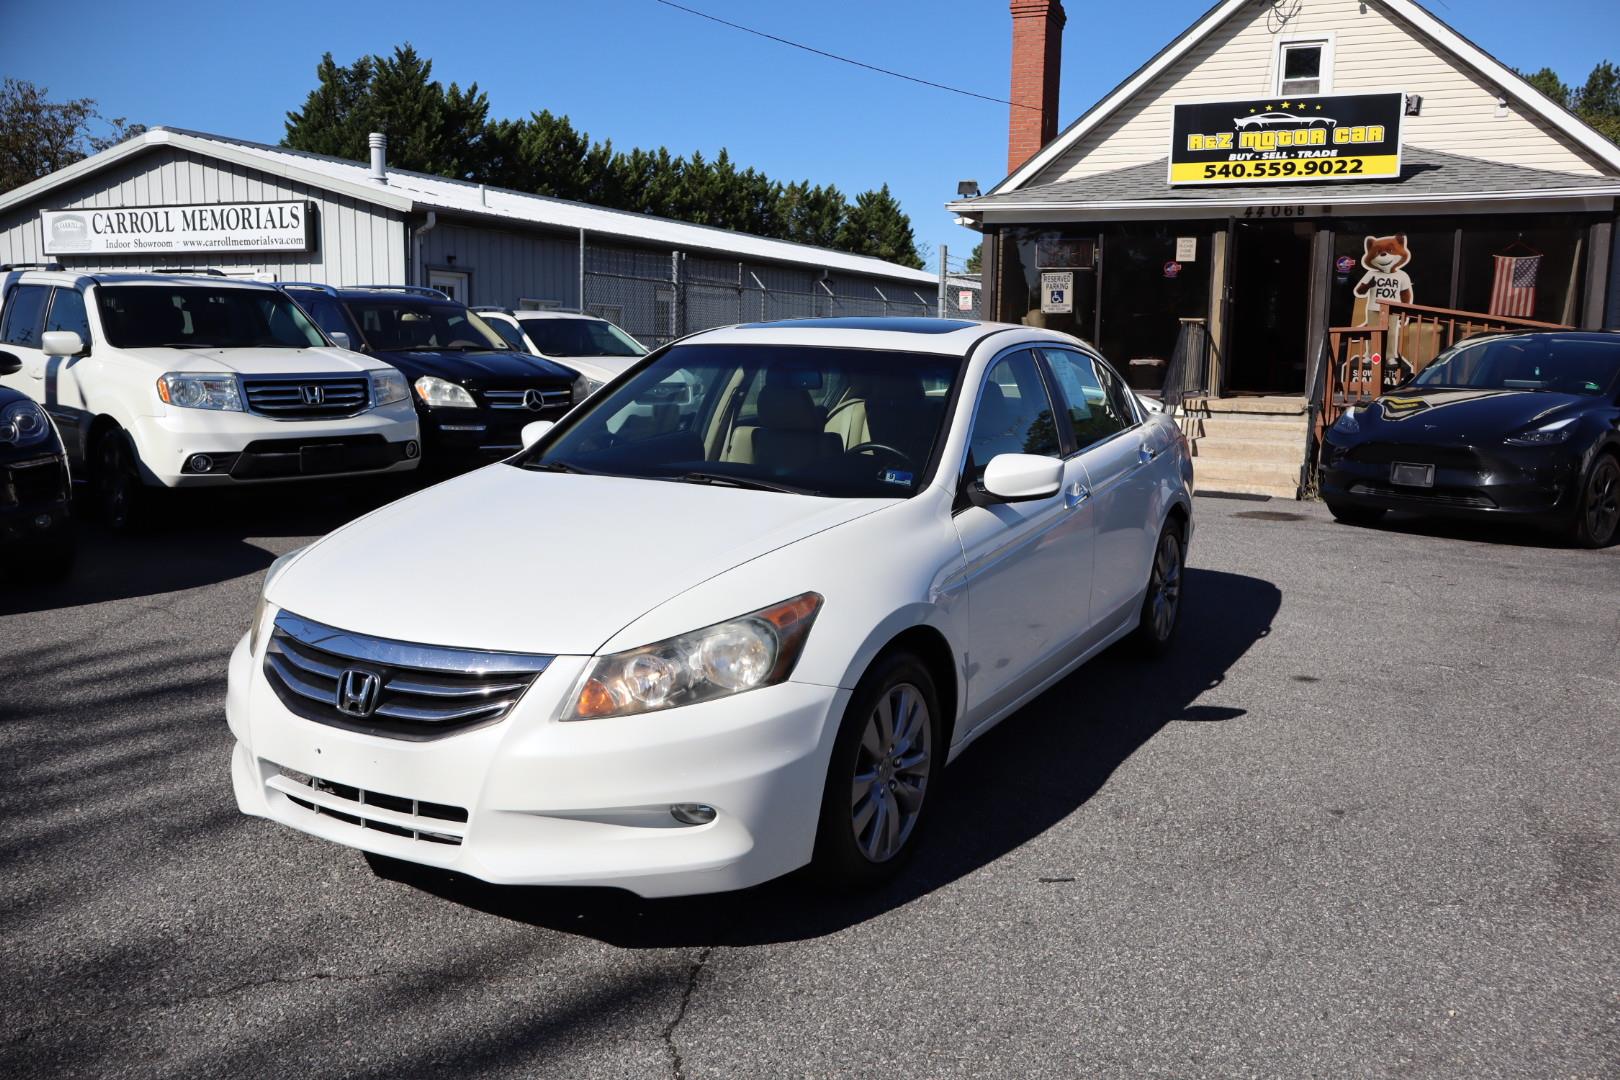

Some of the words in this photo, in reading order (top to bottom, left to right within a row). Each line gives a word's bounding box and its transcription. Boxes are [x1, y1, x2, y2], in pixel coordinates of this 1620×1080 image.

[1228, 152, 1254, 161] BUY
[1261, 151, 1289, 160] SELL
[1297, 149, 1339, 159] TRADE
[1203, 158, 1363, 179] 540.559.9022
[92, 211, 175, 235] CARROLL
[181, 205, 300, 232] MEMORIALS
[105, 238, 131, 249] Indoor
[133, 237, 174, 248] Showroom
[182, 235, 304, 248] www.carrollmemorialsva.com
[1044, 275, 1070, 283] RESERVED
[1376, 277, 1399, 289] CAR
[1375, 288, 1397, 299] FOX
